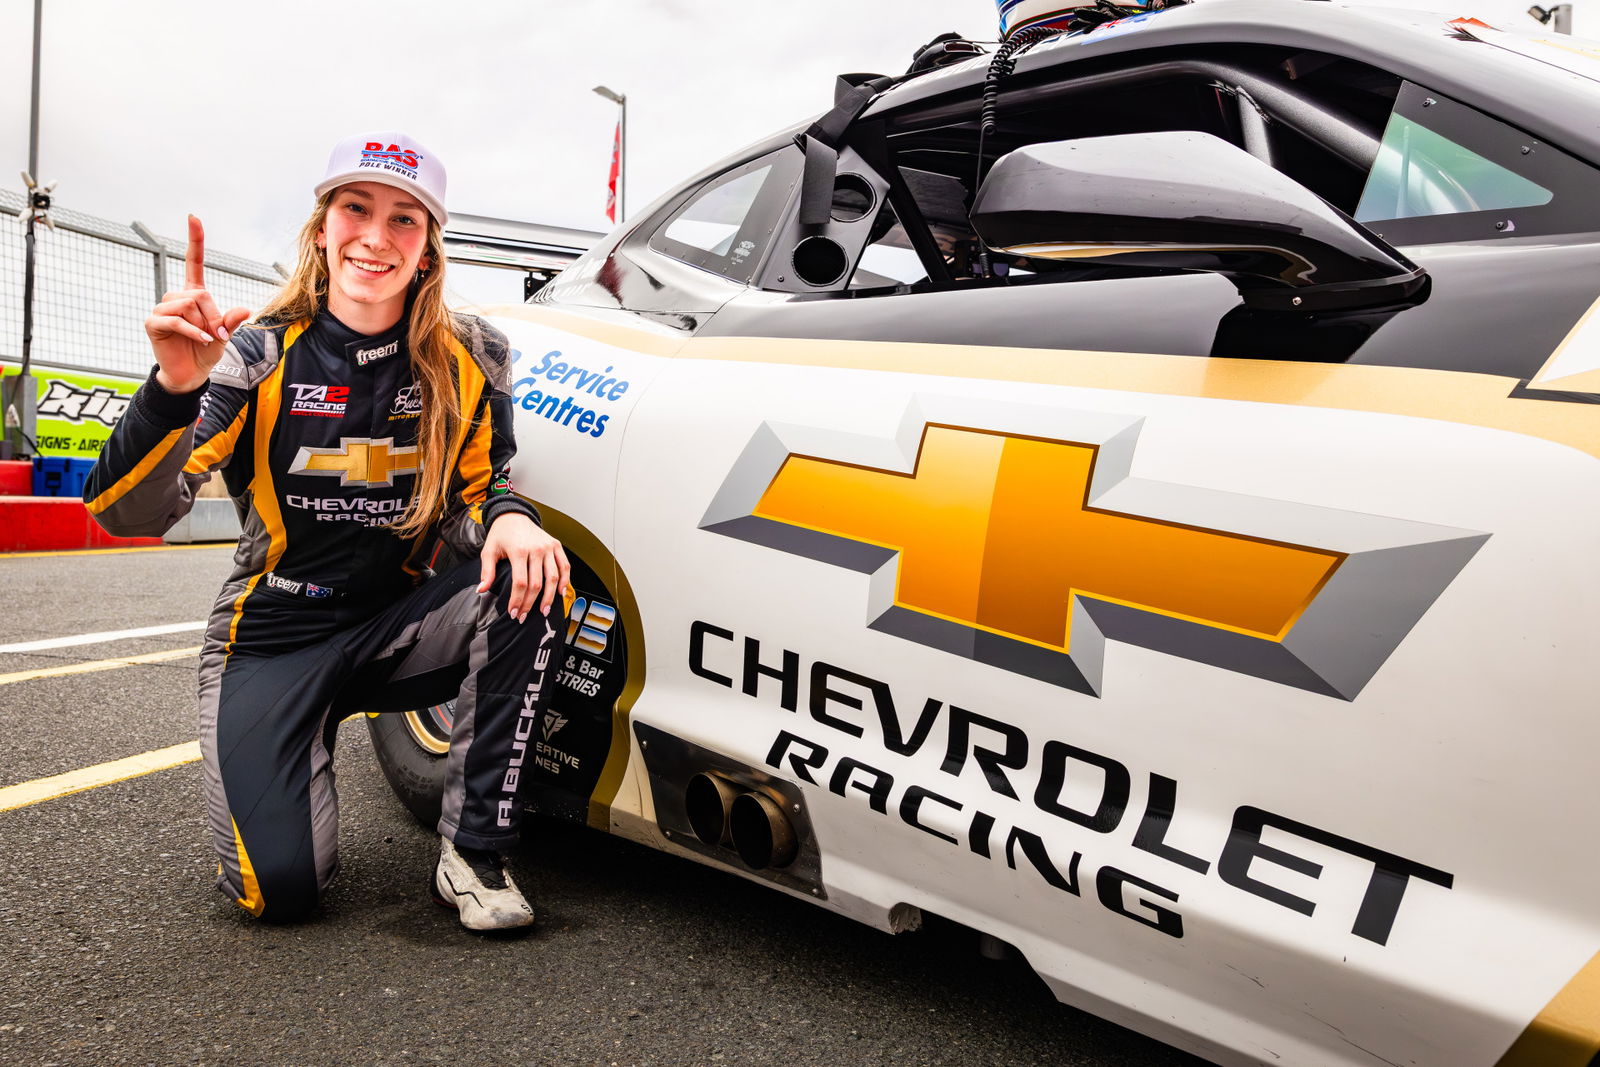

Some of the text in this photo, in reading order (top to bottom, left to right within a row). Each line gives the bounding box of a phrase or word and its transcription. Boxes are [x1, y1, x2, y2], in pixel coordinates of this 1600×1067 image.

[361, 142, 419, 169] RAS
[384, 164, 418, 180] WINNER
[356, 340, 398, 366] freem
[530, 350, 630, 401] Service
[288, 383, 350, 402] TA2
[292, 400, 346, 411] RACING
[512, 377, 610, 438] Centres
[565, 655, 604, 680] & Bar
[502, 619, 556, 793] BUCKLEY
[535, 755, 560, 775] NES
[689, 620, 1455, 947] CHEVROLET
[765, 730, 1184, 938] RACING
